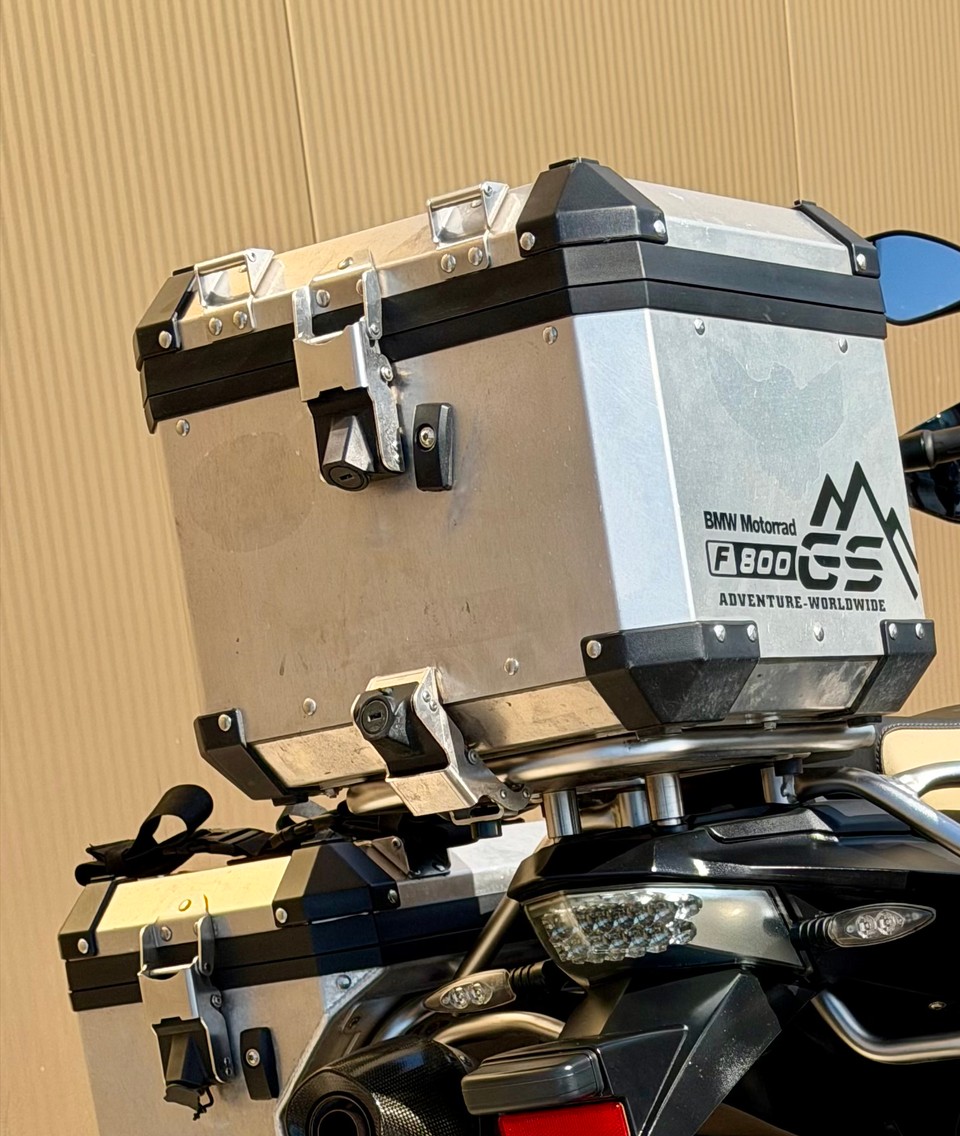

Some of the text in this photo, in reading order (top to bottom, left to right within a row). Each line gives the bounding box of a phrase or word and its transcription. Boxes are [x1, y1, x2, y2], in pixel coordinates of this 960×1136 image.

[703, 510, 798, 537] BMW Motorrad
[713, 532, 885, 592] F 800 GS
[718, 592, 887, 613] ADVENTURE-WORLDWIDE
